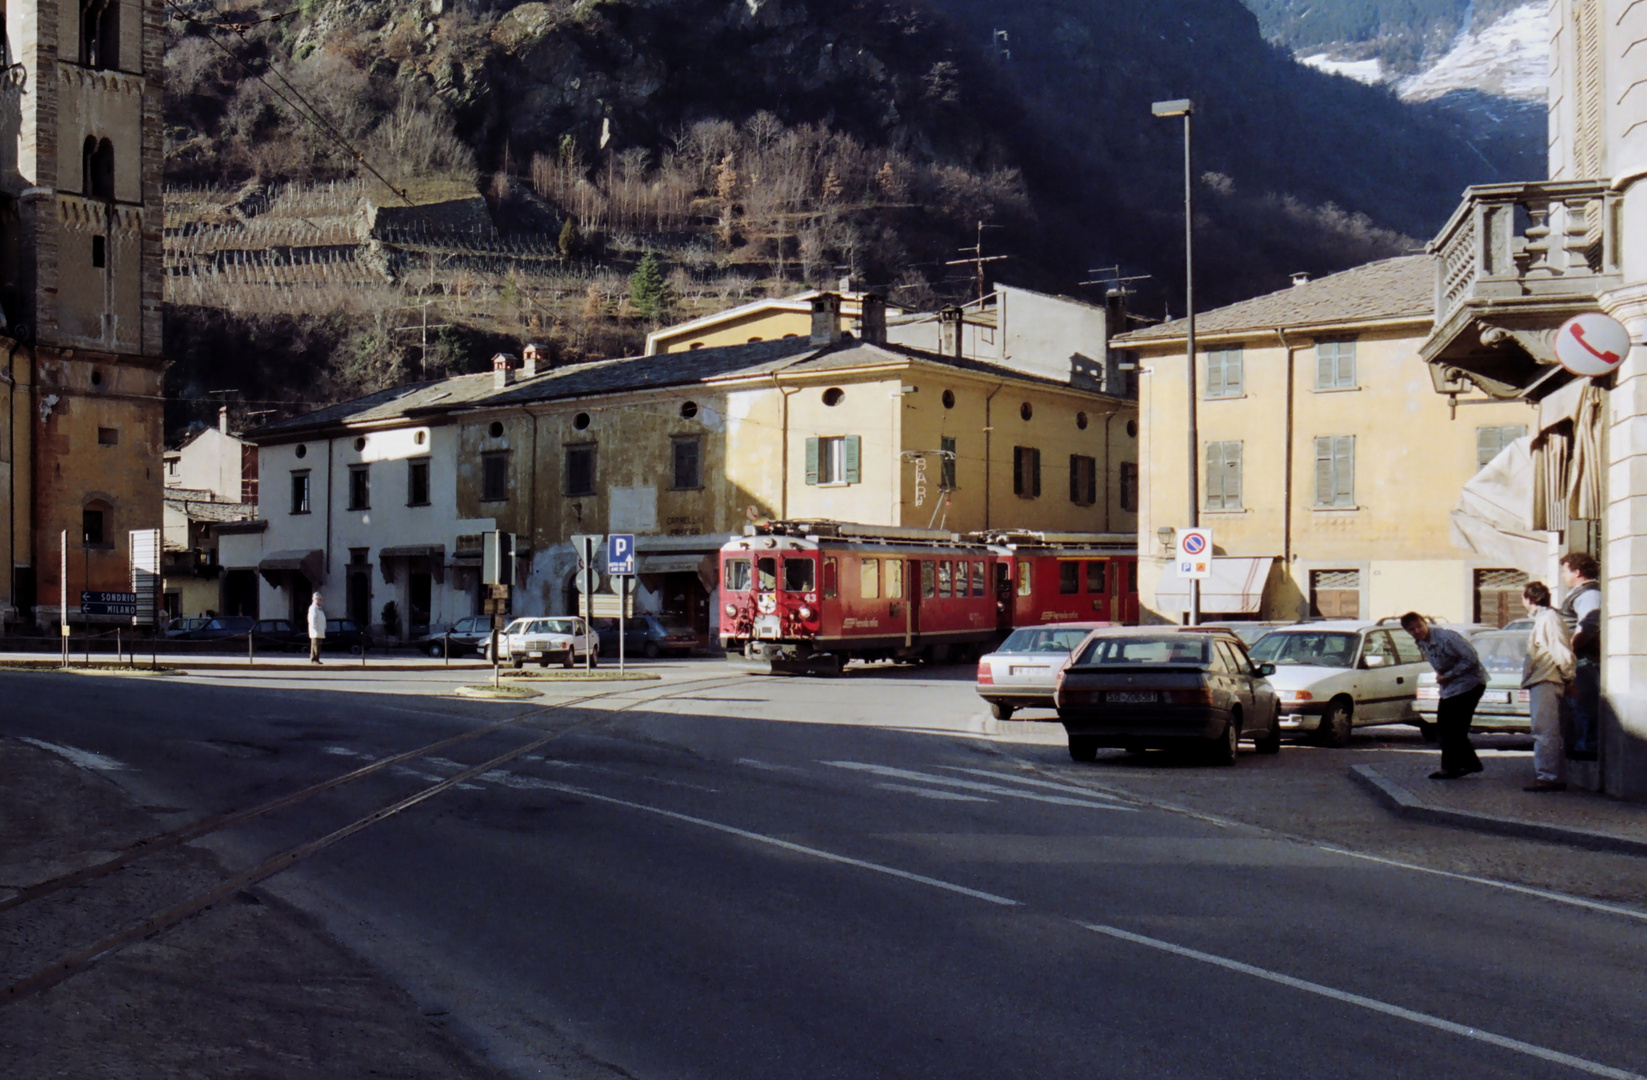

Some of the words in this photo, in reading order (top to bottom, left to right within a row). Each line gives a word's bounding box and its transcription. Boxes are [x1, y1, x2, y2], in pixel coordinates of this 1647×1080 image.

[915, 458, 926, 499] BAR
[615, 538, 627, 556] P
[101, 593, 135, 602] SONDRIO
[804, 593, 817, 602] 43
[107, 605, 135, 614] MILANO
